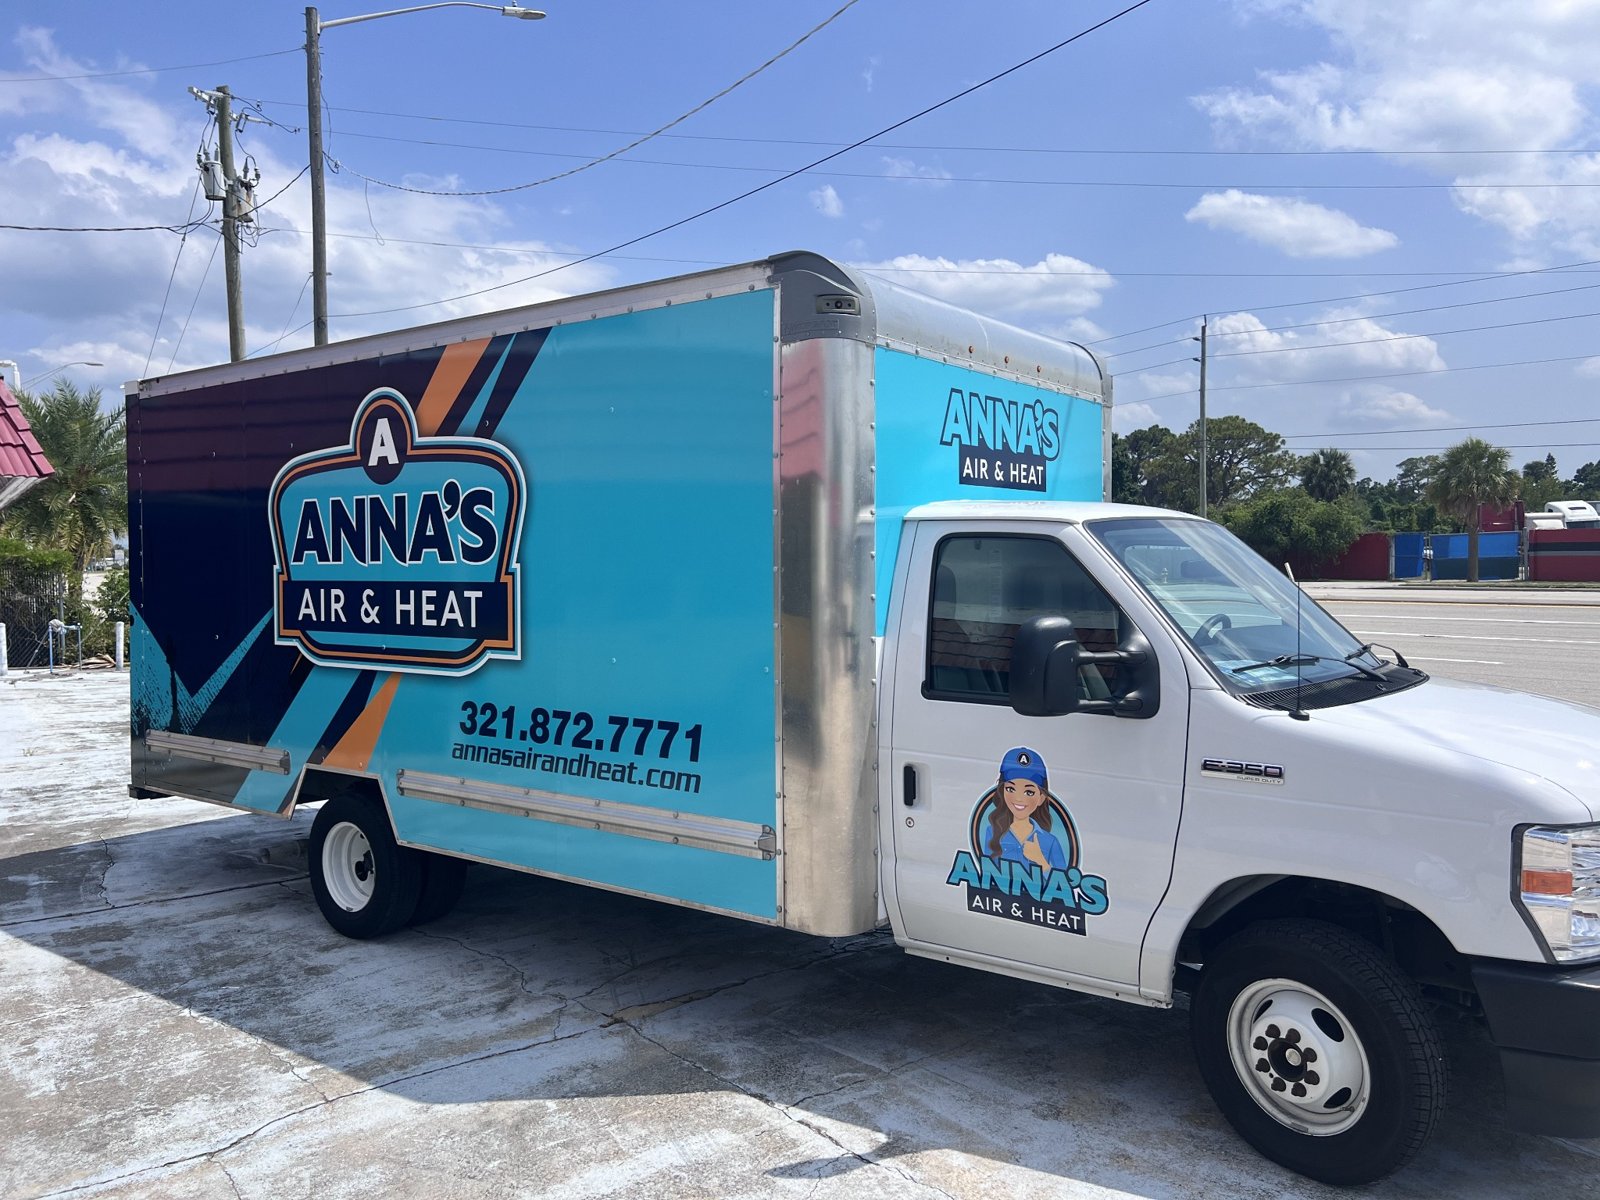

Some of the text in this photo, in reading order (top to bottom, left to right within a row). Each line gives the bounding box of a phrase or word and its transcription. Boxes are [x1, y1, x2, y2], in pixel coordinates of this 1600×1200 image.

[368, 417, 399, 466] A
[940, 387, 1060, 461] ANNA'S
[962, 456, 1044, 485] AIR & HEAT
[290, 478, 498, 567] ANNA'S
[298, 588, 483, 628] AIR & HEAT
[459, 700, 703, 763] 321.872.7771
[451, 742, 702, 794] annasairandheat.com
[1202, 758, 1283, 779] E-350
[946, 850, 1110, 916] ANNA'S
[972, 895, 1081, 930] AIR & HEAT
